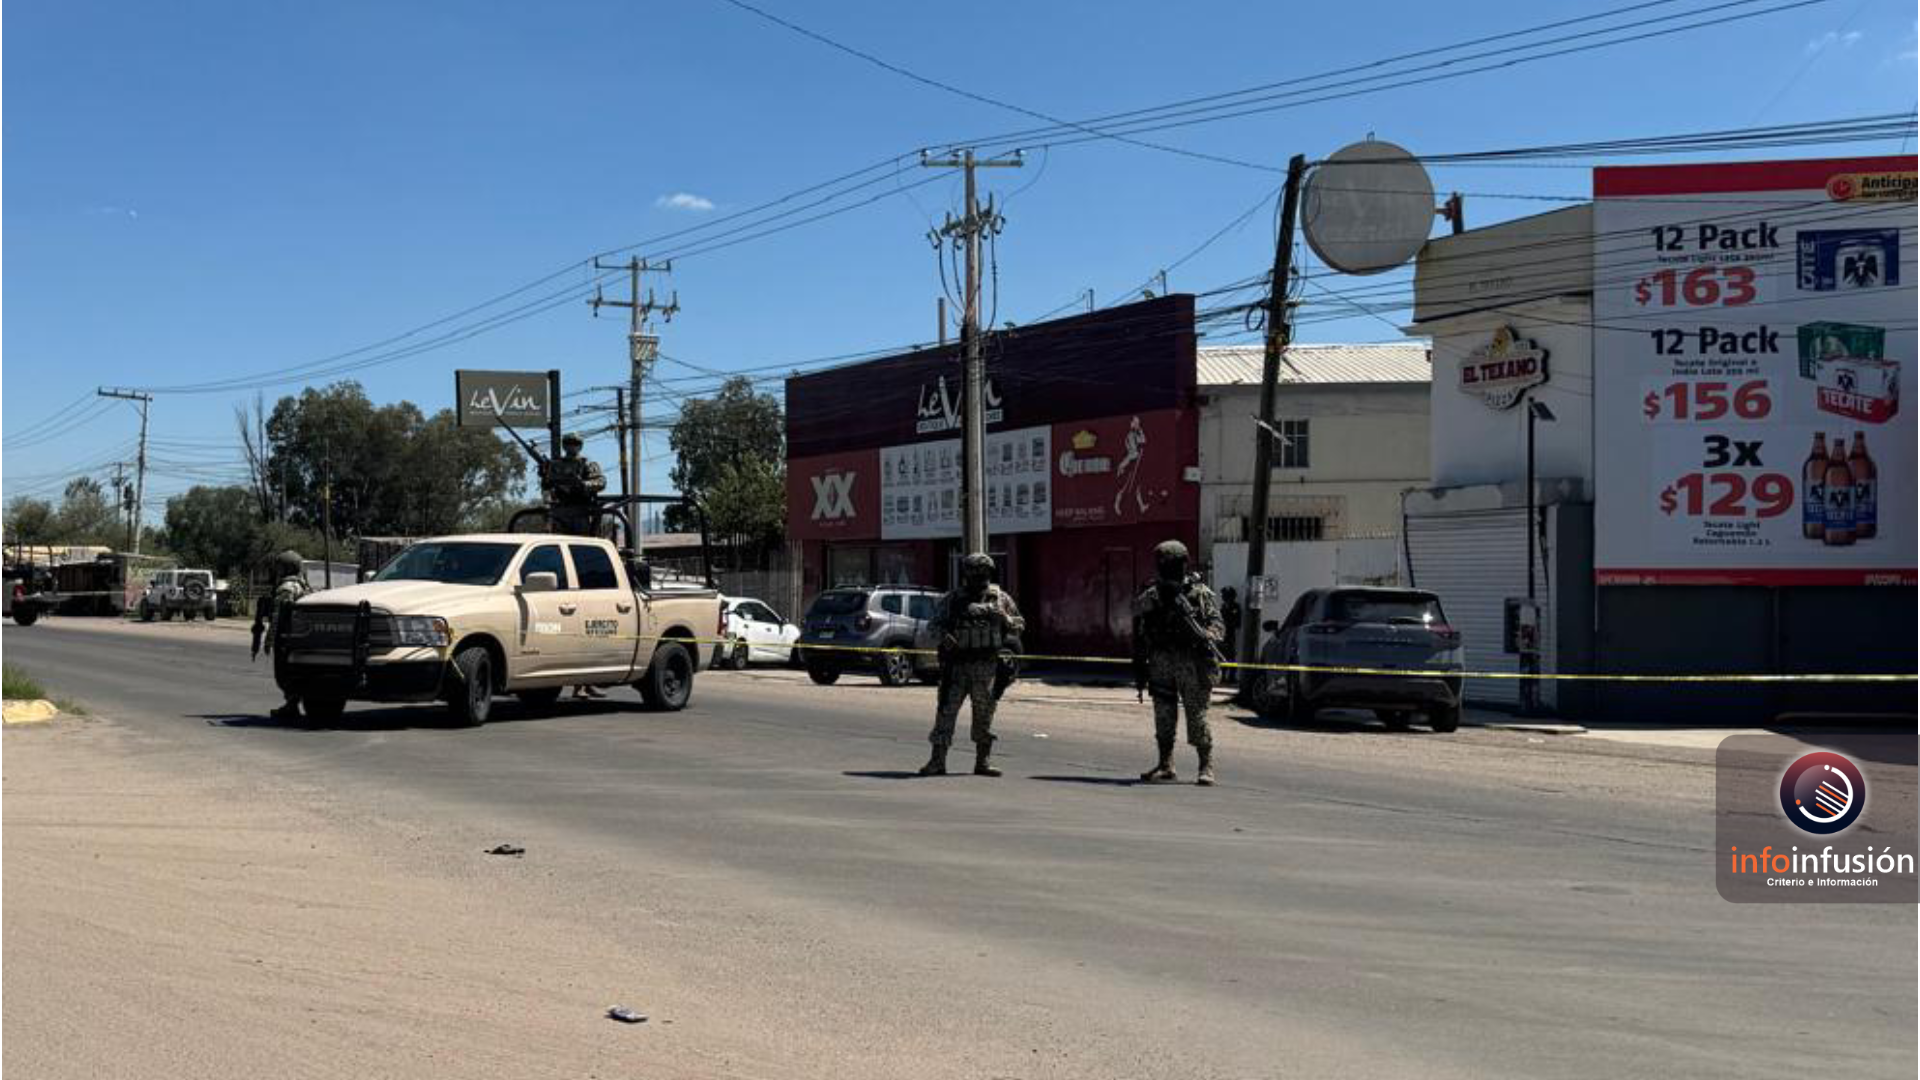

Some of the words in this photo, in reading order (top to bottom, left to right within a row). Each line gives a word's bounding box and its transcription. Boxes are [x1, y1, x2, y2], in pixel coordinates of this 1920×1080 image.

[1651, 227, 1684, 251] 12
[1699, 222, 1779, 250] Pack
[1635, 266, 1756, 307] $163
[1651, 328, 1684, 354] 12
[1699, 325, 1779, 354] Pack
[1463, 366, 1479, 383] EL
[1480, 357, 1538, 382] TEXANO
[1643, 379, 1772, 420] $156
[1822, 388, 1874, 415] TECATE
[1703, 434, 1764, 468] 3x
[810, 471, 857, 521] XX
[1660, 473, 1794, 518] $129
